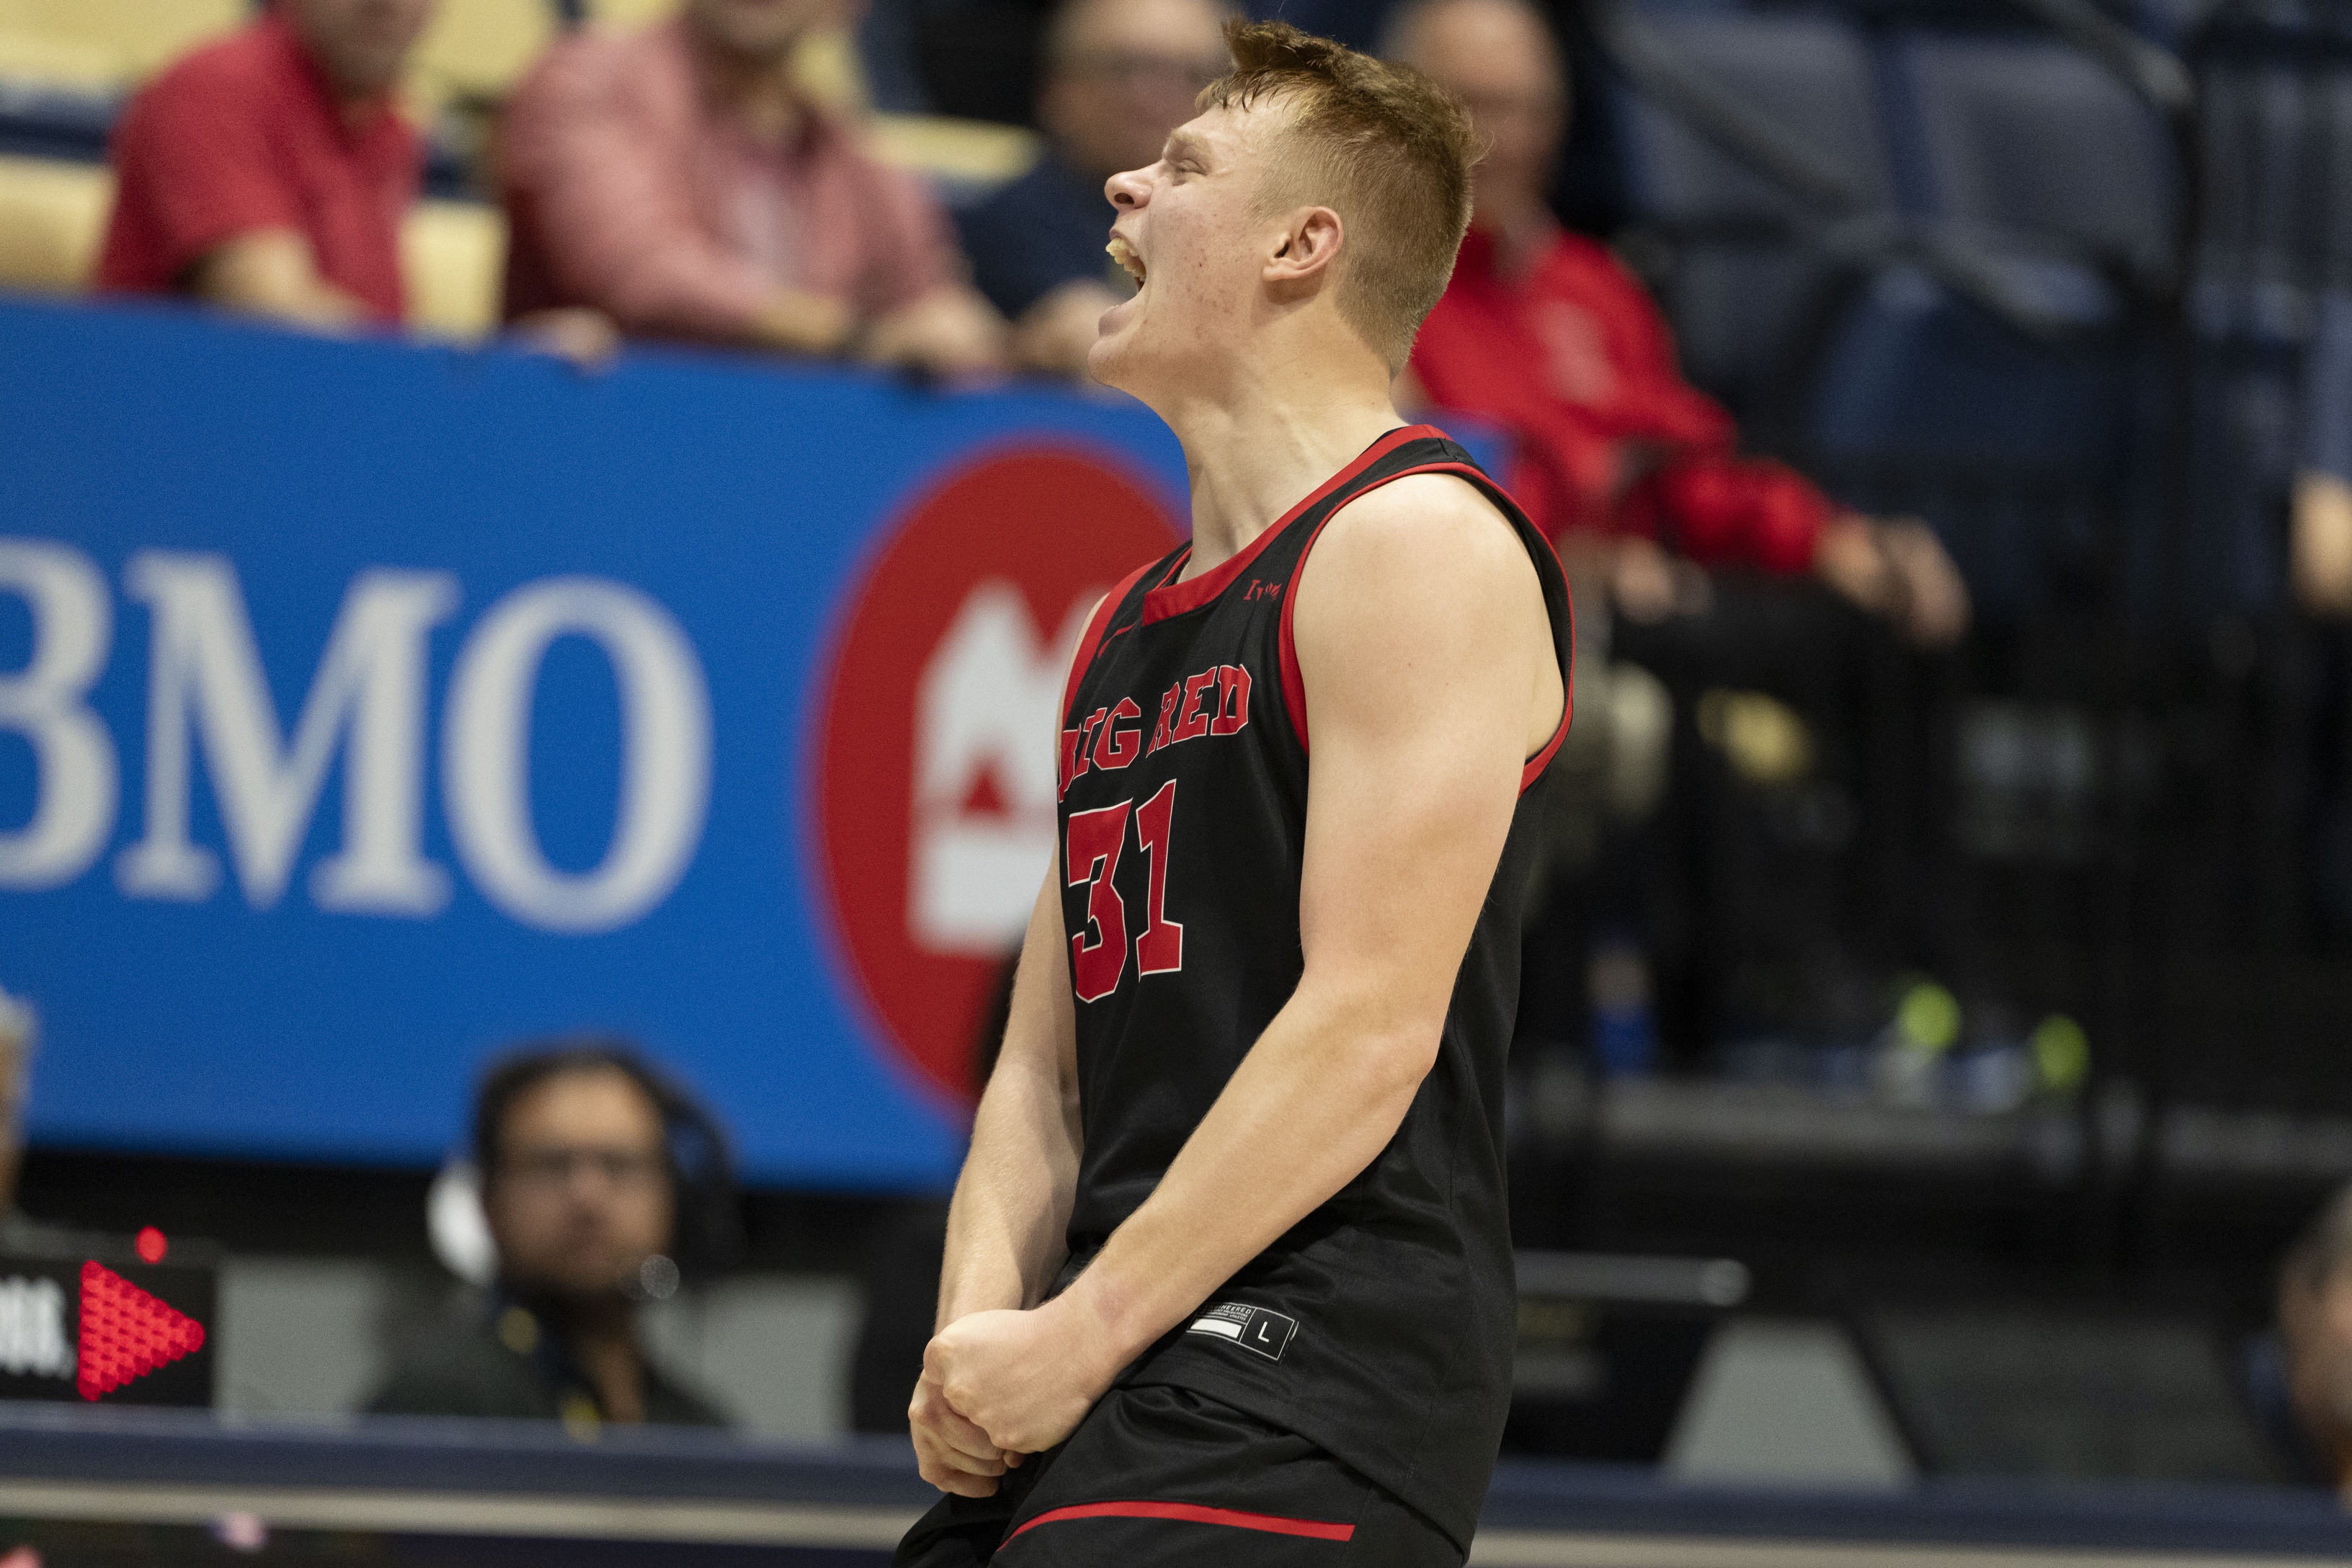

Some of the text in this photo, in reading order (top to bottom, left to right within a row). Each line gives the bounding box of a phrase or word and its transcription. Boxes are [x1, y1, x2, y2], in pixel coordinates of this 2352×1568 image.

[0, 536, 715, 935] BMO
[1146, 664, 1252, 759] RED
[1066, 778, 1183, 1004] 31
[1258, 1322, 1270, 1342] L
